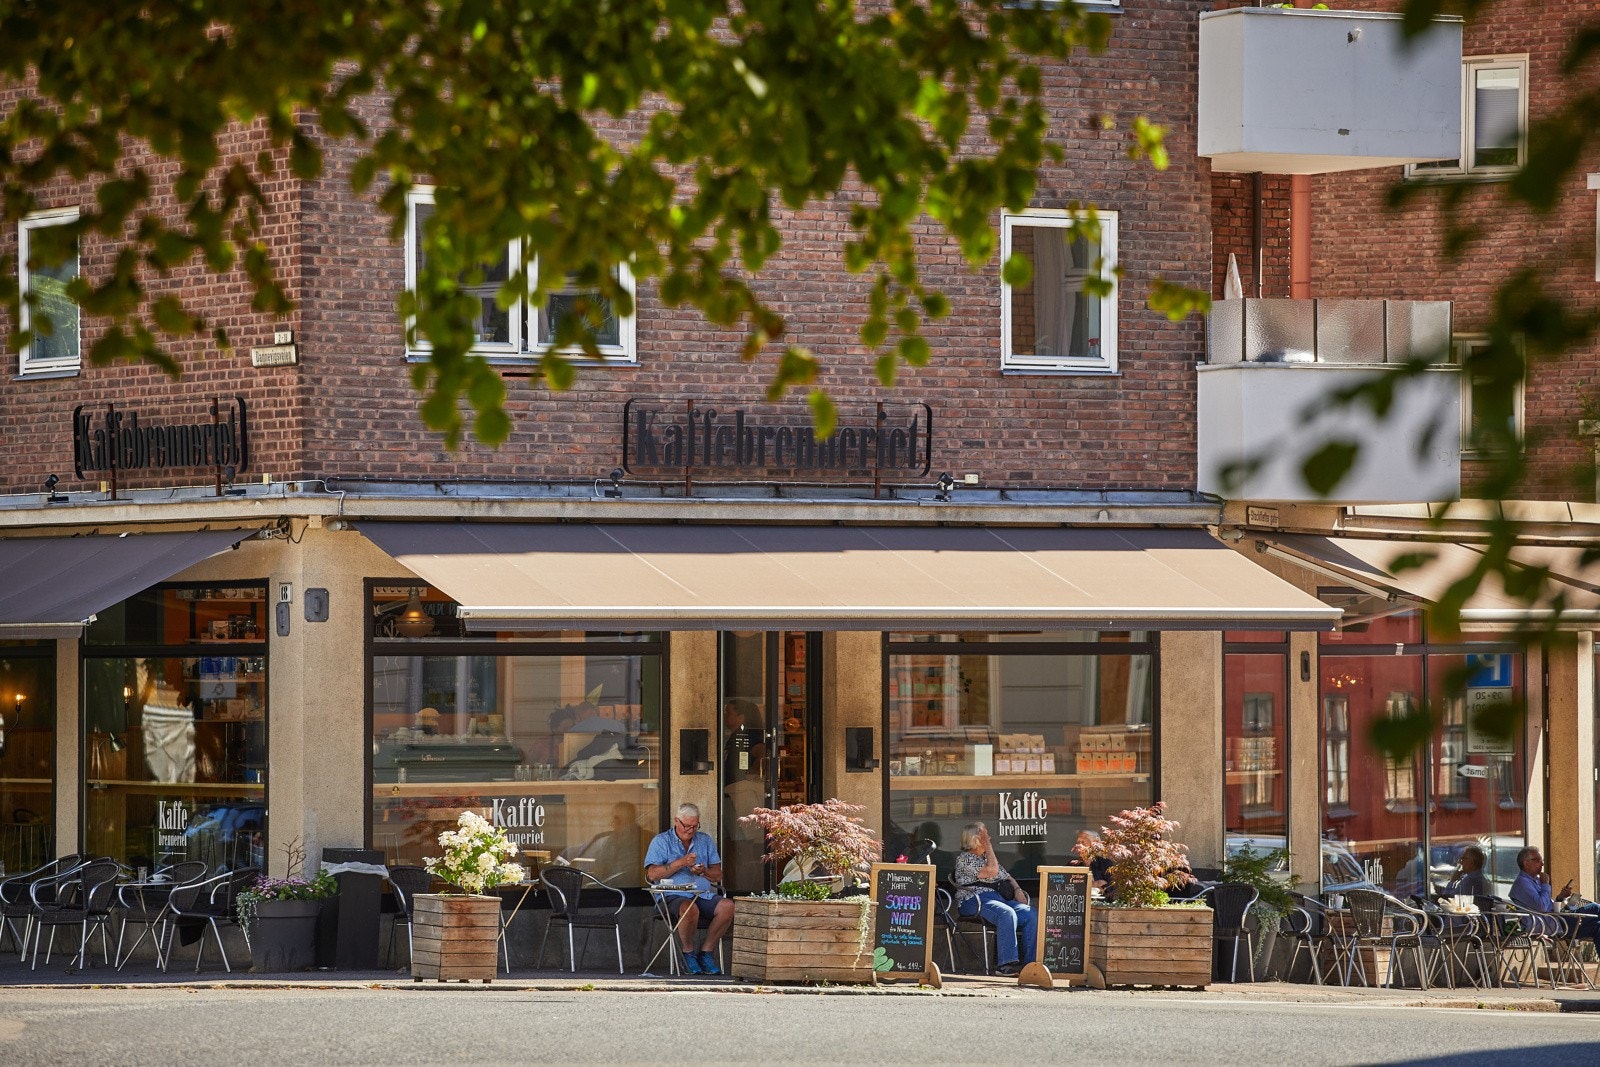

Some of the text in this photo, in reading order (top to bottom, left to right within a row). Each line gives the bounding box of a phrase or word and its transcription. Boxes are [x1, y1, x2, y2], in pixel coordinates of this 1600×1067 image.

[79, 405, 240, 471] Kaffebrenneriet
[635, 408, 922, 470] Kaffebrenneriet
[281, 585, 288, 600] 18
[159, 800, 188, 830] Kaffe
[492, 797, 545, 828] Kaffe
[998, 791, 1048, 820] Kaffe
[494, 829, 545, 845] nneriet
[999, 821, 1048, 836] brenneriet
[158, 831, 188, 847] brenneriet
[885, 894, 922, 911] SOMMER
[890, 911, 914, 926] NATT
[1058, 946, 1081, 967] 42
